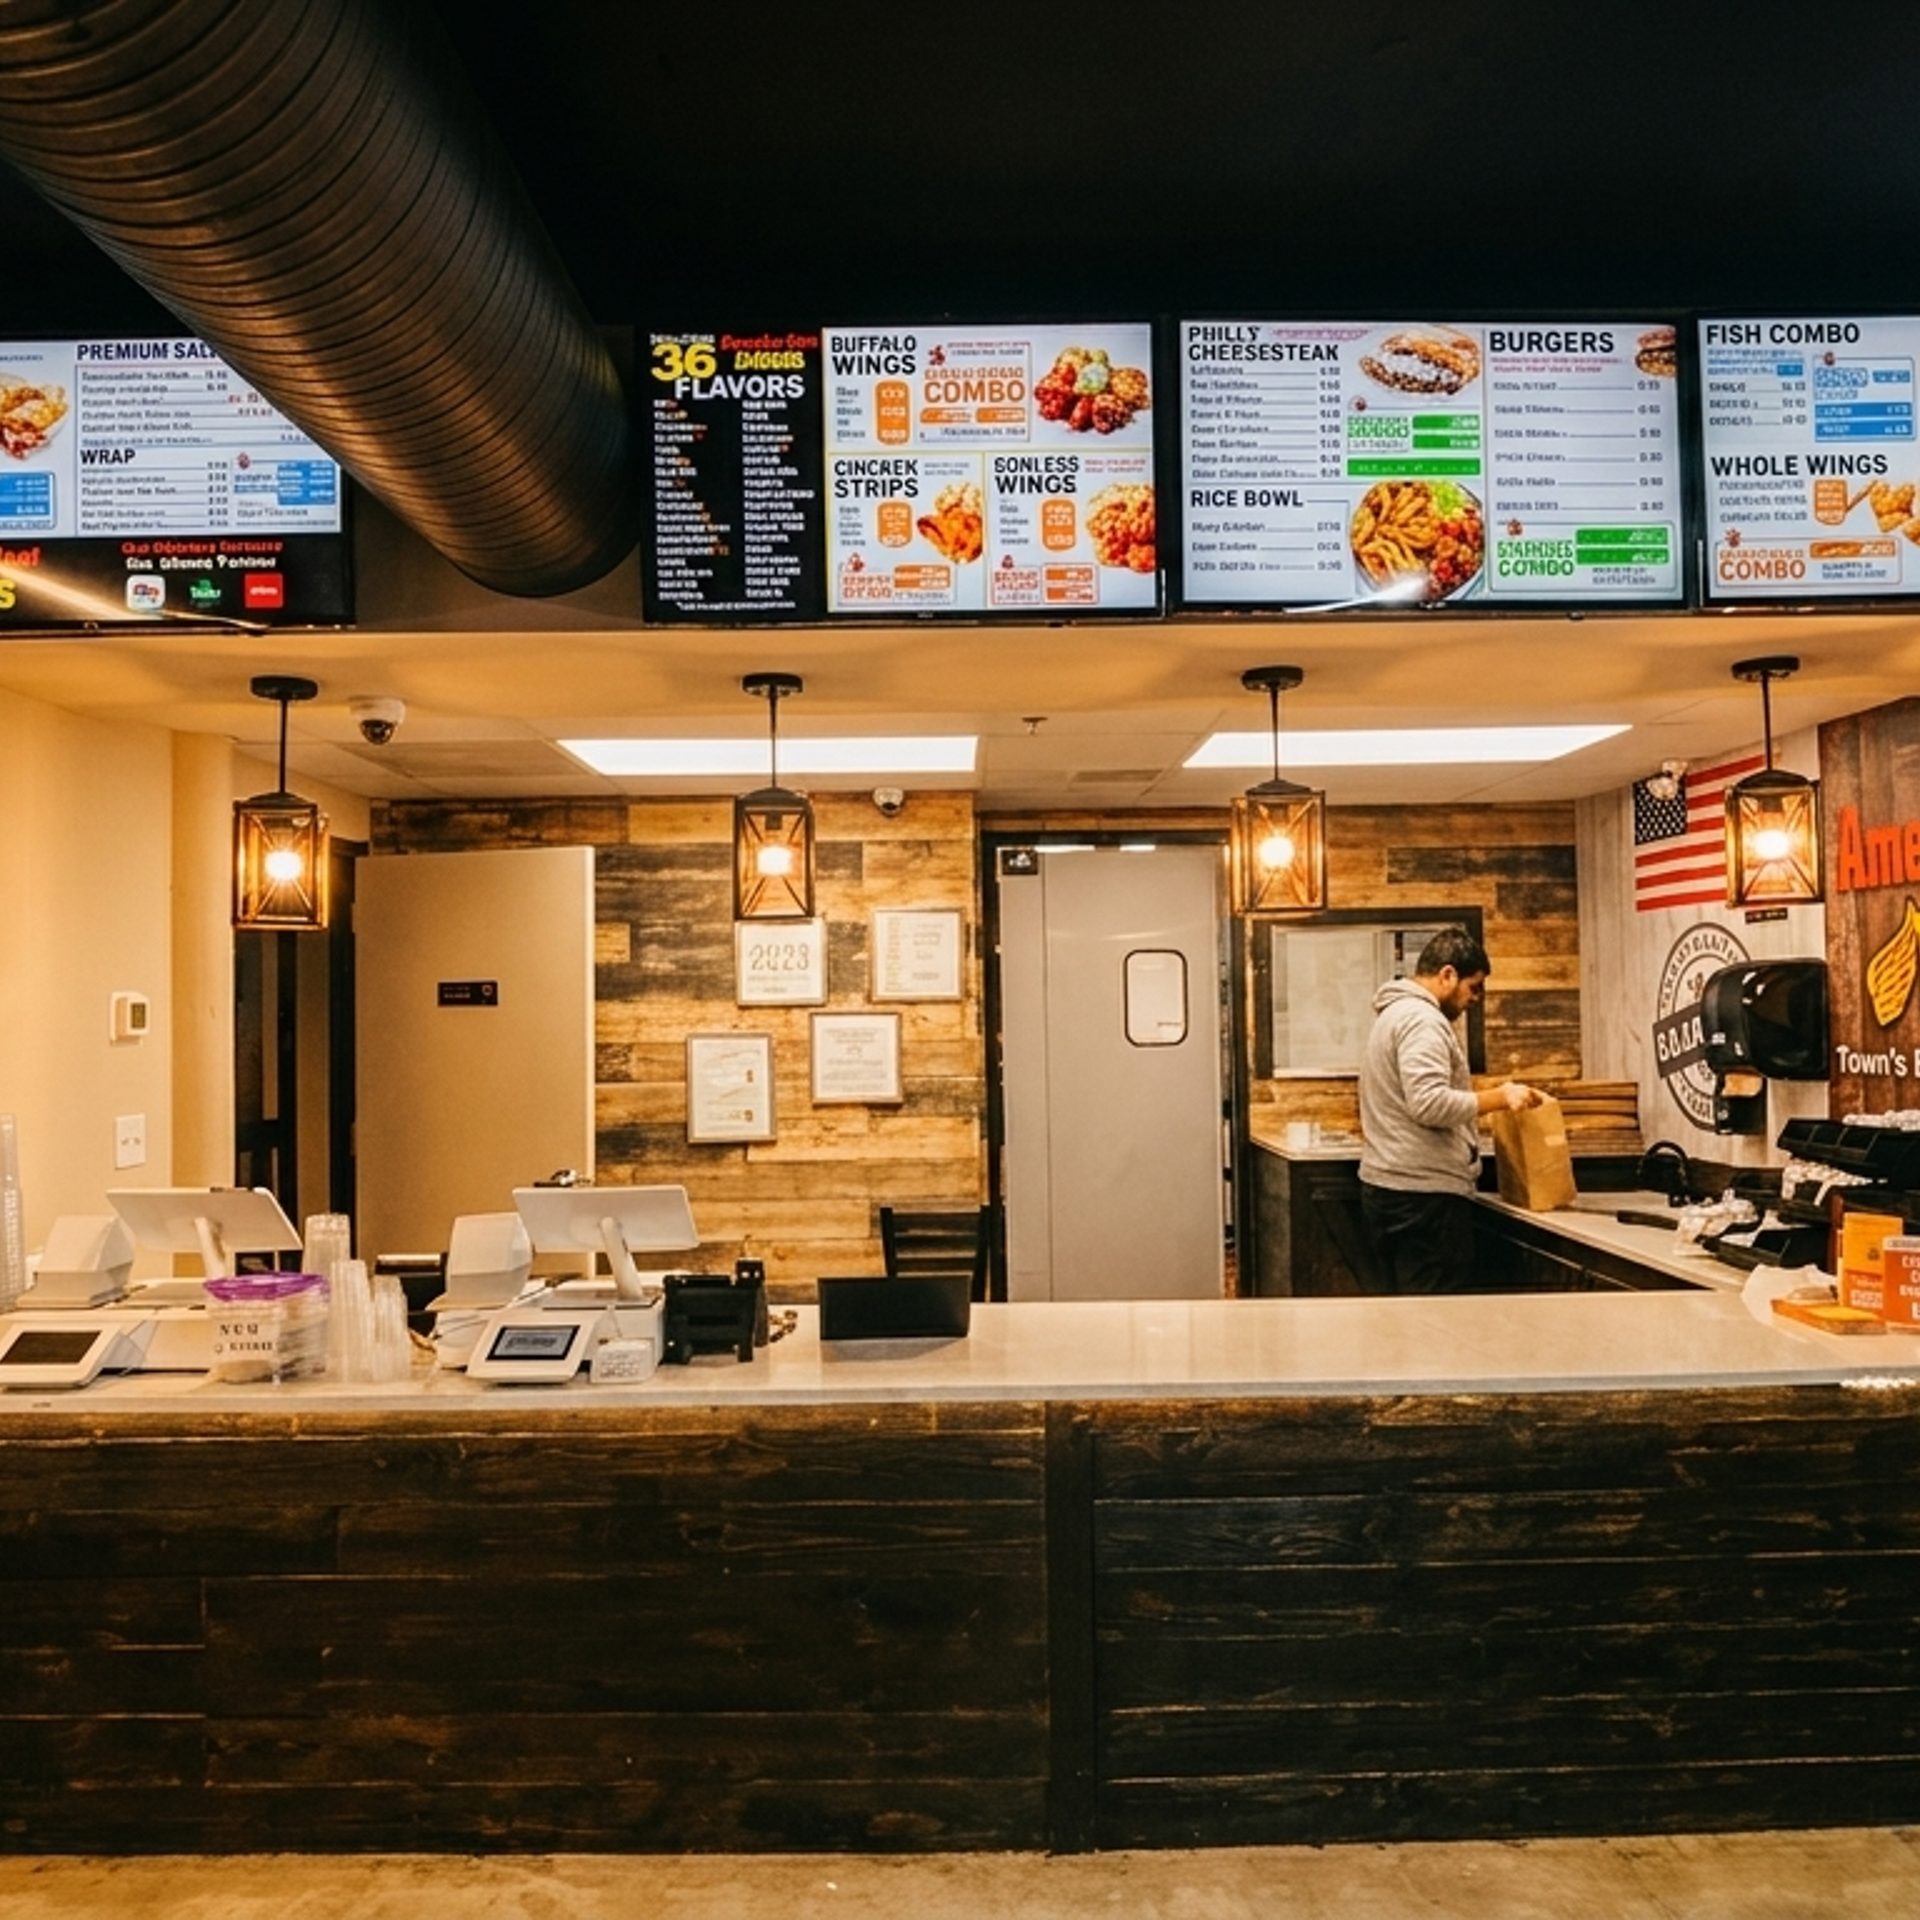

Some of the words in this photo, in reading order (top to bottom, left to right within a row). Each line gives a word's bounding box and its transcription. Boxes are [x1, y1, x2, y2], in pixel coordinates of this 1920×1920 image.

[831, 335, 916, 353] BUFFALO
[1189, 326, 1260, 342] PHILLY
[1490, 332, 1614, 353] BURGERS
[1706, 325, 1761, 344] FISH
[1769, 324, 1860, 344] COMBO
[77, 343, 168, 360] PREMIUM
[1189, 344, 1338, 361] CHEESESTEAK
[651, 343, 717, 381] 36
[832, 355, 916, 375] WINGS
[675, 375, 805, 399] FLAVORS
[924, 381, 1025, 403] COMBO
[80, 449, 135, 464] WRAP
[1711, 456, 1798, 476] WHOLE
[1806, 454, 1888, 475] WINGS
[834, 479, 918, 498] STRIPS
[994, 475, 1076, 494] WINGS
[1191, 490, 1238, 507] RICE
[1244, 490, 1303, 507] BOWL
[1719, 559, 1805, 580] COMBO
[1836, 1044, 1908, 1078] Town's
